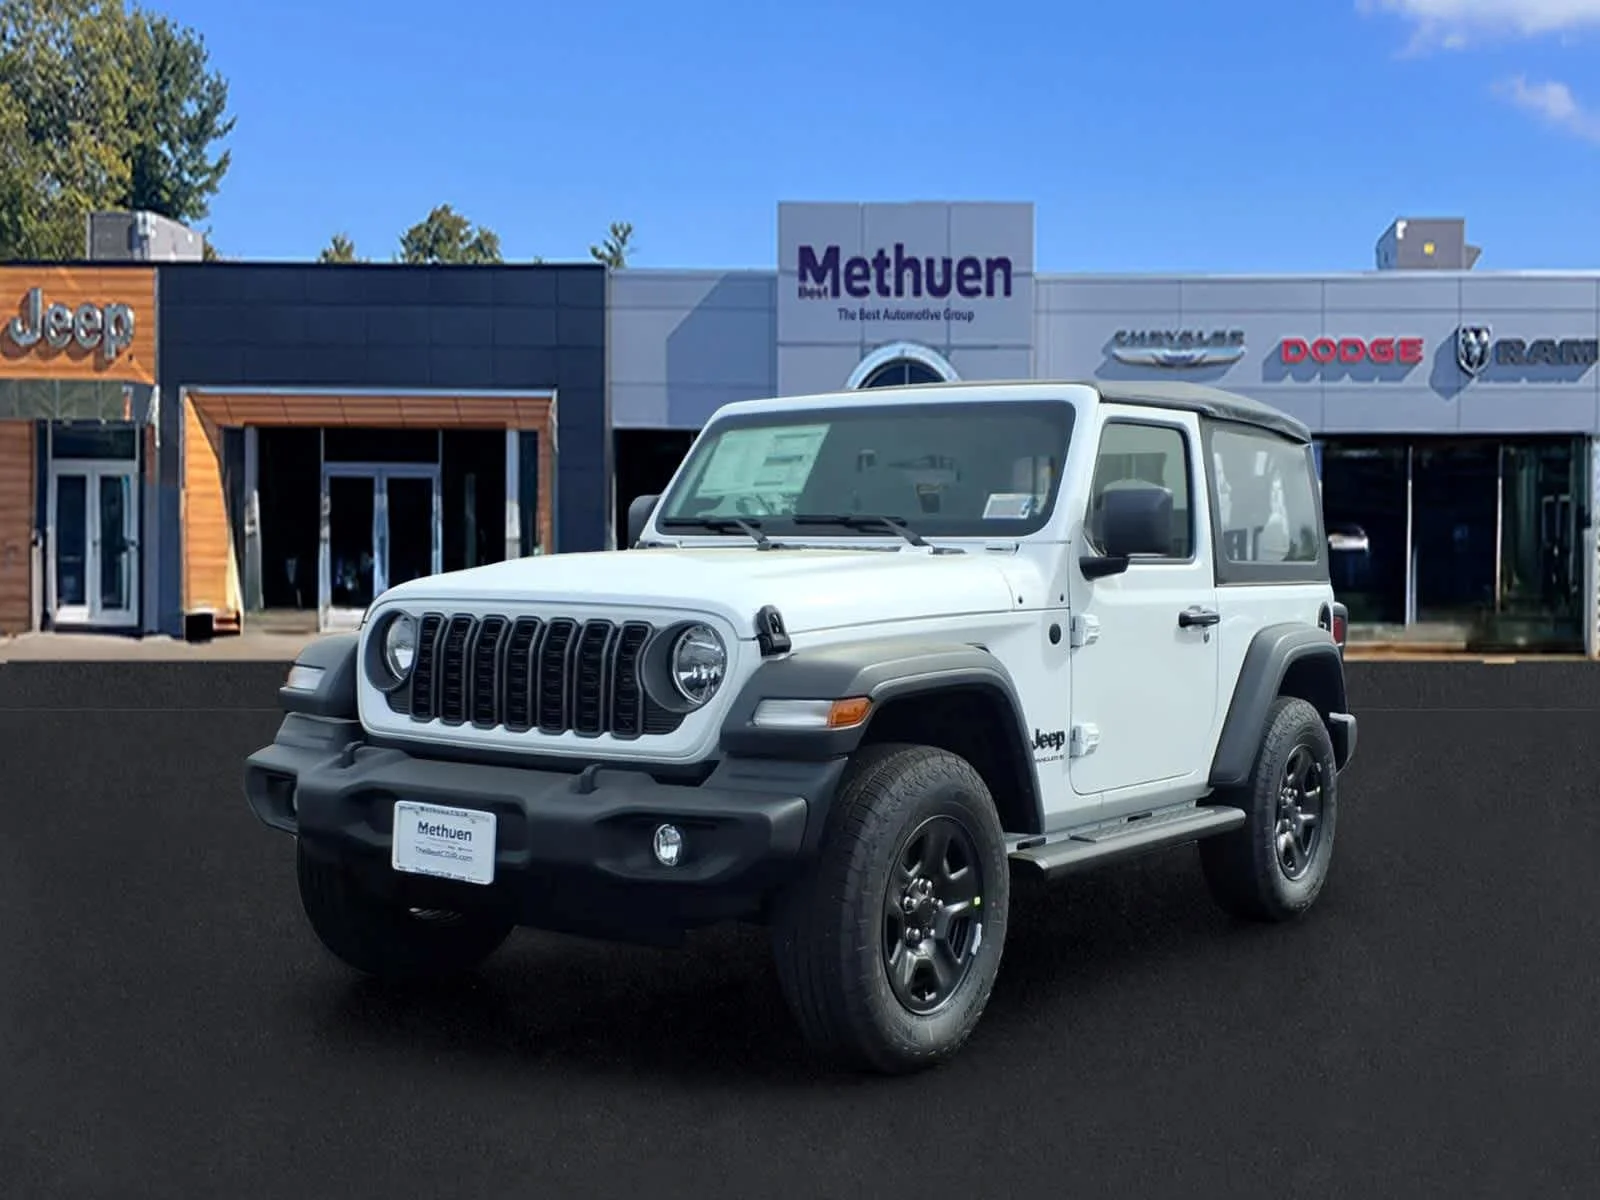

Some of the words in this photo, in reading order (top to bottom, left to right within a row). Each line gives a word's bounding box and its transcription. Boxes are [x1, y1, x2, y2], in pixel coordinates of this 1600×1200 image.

[798, 242, 1012, 298] Methuen
[798, 285, 829, 299] Best
[9, 287, 136, 359] Jeep
[838, 307, 857, 320] The
[859, 307, 880, 320] Best
[883, 307, 941, 321] Automotive
[943, 307, 974, 323] Group
[1114, 329, 1245, 348] CHRYSLER
[1281, 337, 1425, 364] DODGE
[1496, 338, 1599, 365] RAM
[1032, 728, 1065, 751] Jeep
[418, 820, 473, 841] Methuen
